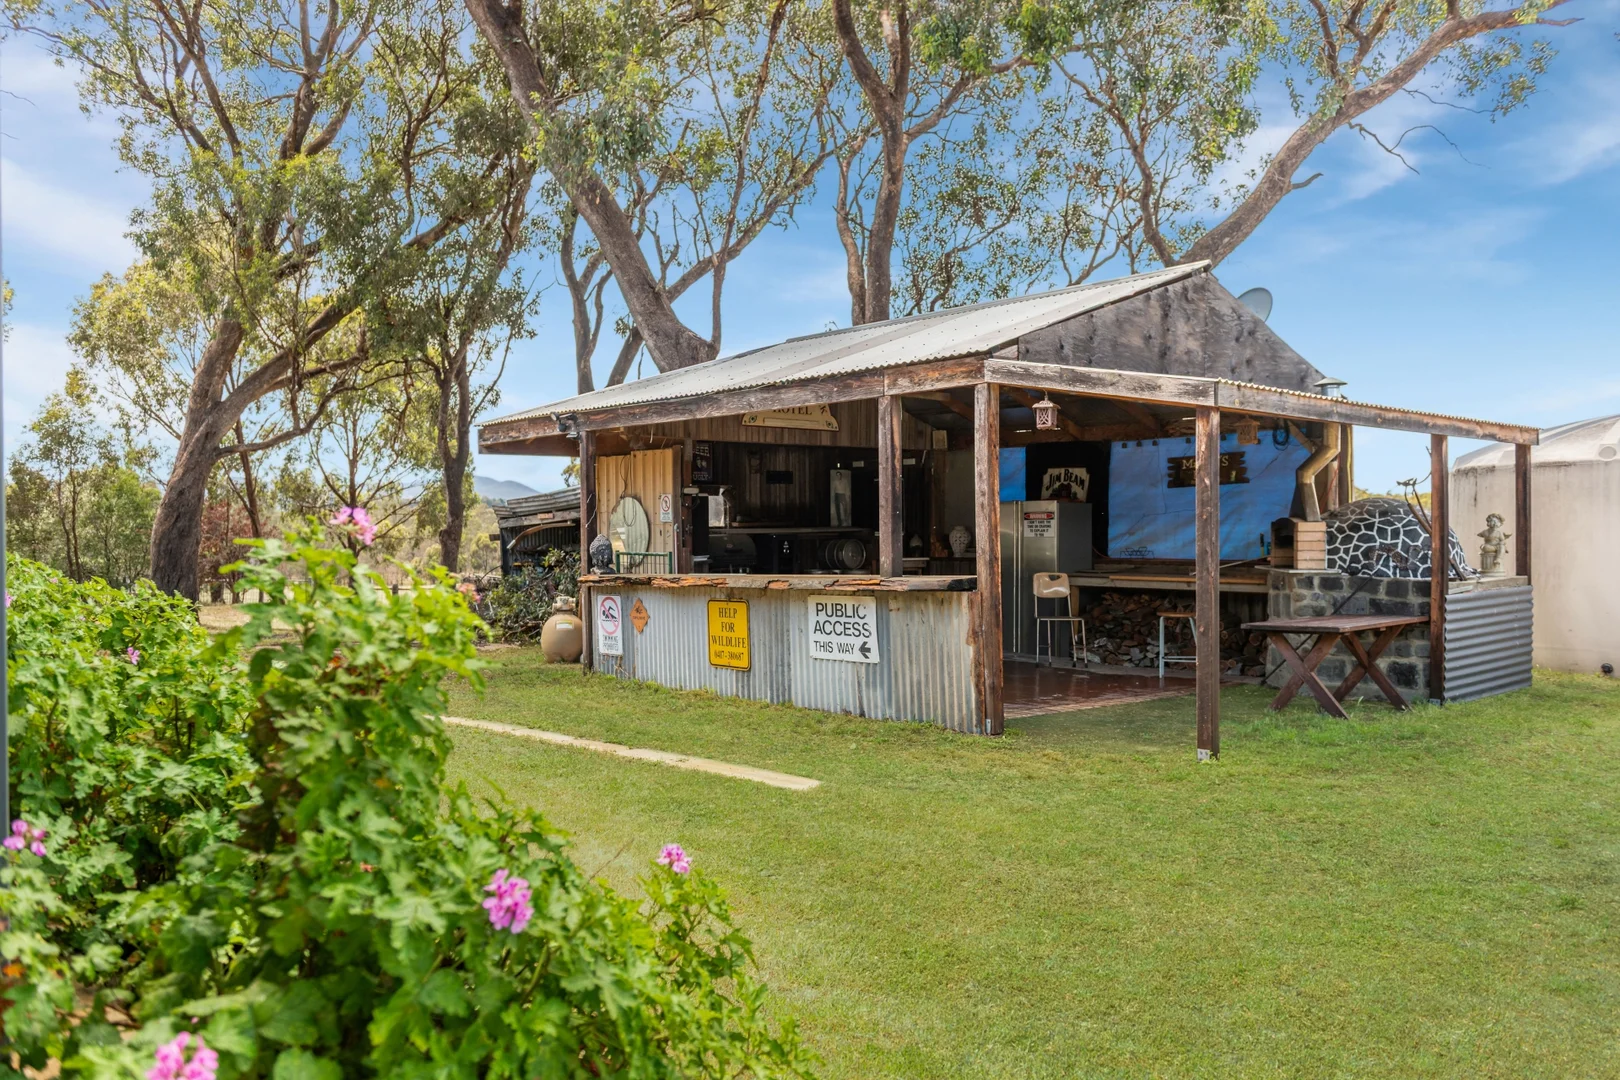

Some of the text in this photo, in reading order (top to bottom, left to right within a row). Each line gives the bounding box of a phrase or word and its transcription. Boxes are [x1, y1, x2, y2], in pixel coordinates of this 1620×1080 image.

[692, 446, 710, 457] EER
[1045, 468, 1086, 491] JIM BEAM
[718, 607, 738, 619] HELP
[815, 602, 867, 620] PUBLIC
[721, 621, 736, 633] FOR
[813, 619, 872, 638] ACCESS
[711, 634, 747, 649] WILDLIFE
[813, 640, 856, 655] THIS WAY
